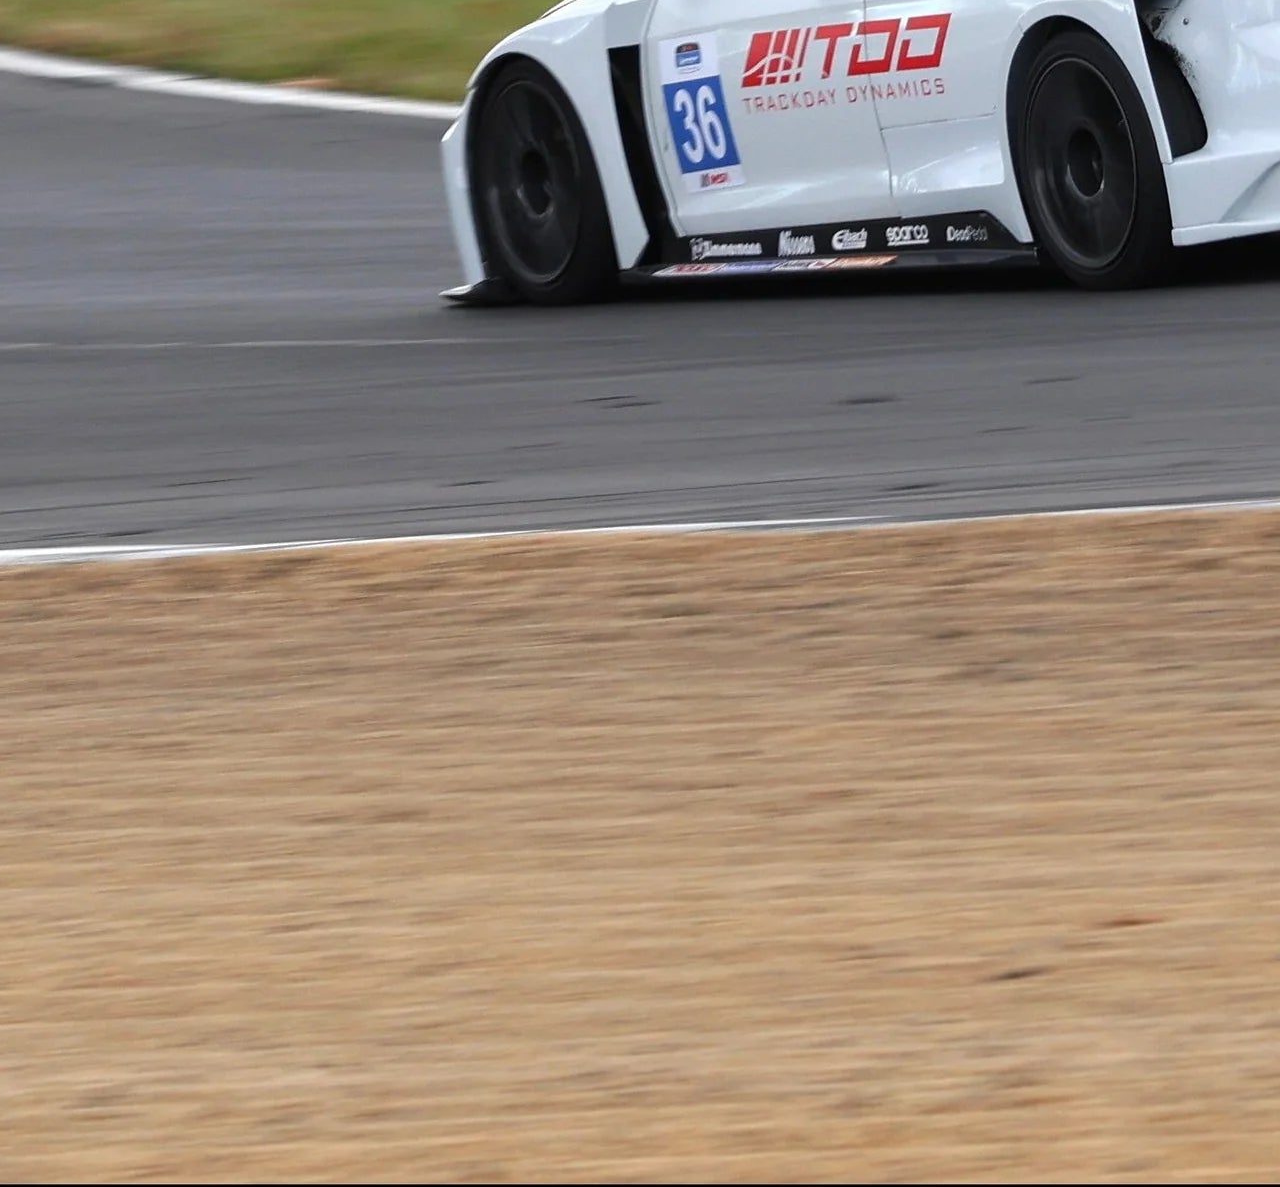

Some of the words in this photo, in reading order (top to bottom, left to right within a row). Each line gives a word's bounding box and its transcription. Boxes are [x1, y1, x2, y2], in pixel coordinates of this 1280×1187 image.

[814, 13, 952, 79] TDD
[674, 85, 726, 163] 36
[741, 89, 836, 113] TRACKDAY
[847, 78, 945, 103] DYNAMICS
